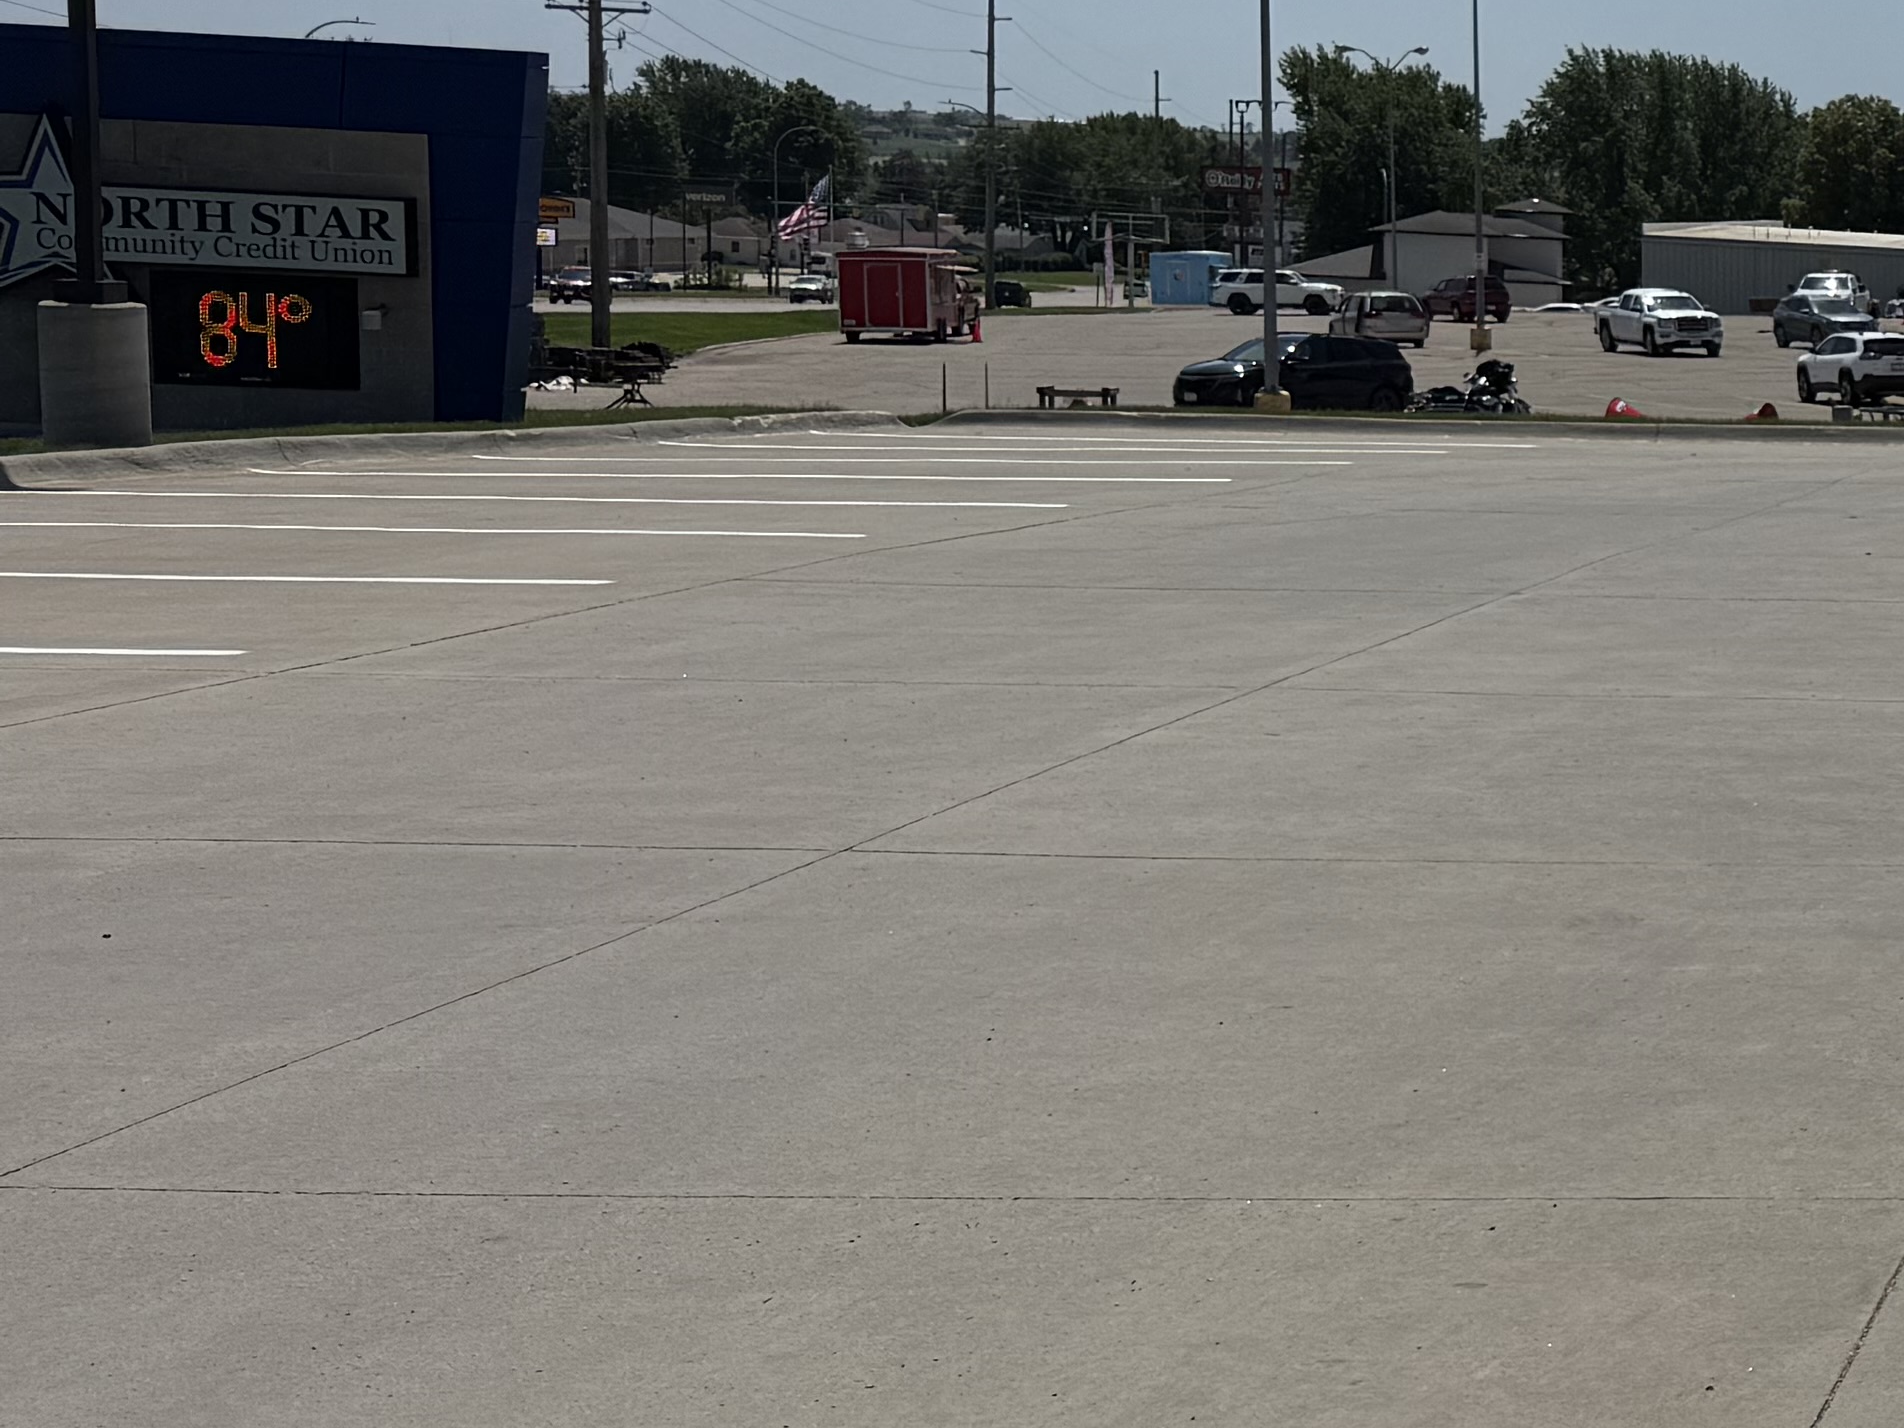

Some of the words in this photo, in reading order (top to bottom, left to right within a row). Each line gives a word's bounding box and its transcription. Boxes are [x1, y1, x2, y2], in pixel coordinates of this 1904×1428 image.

[250, 201, 397, 242] STAR
[36, 226, 204, 260] Comunity
[213, 235, 301, 261] Credit
[309, 239, 393, 265] Union
